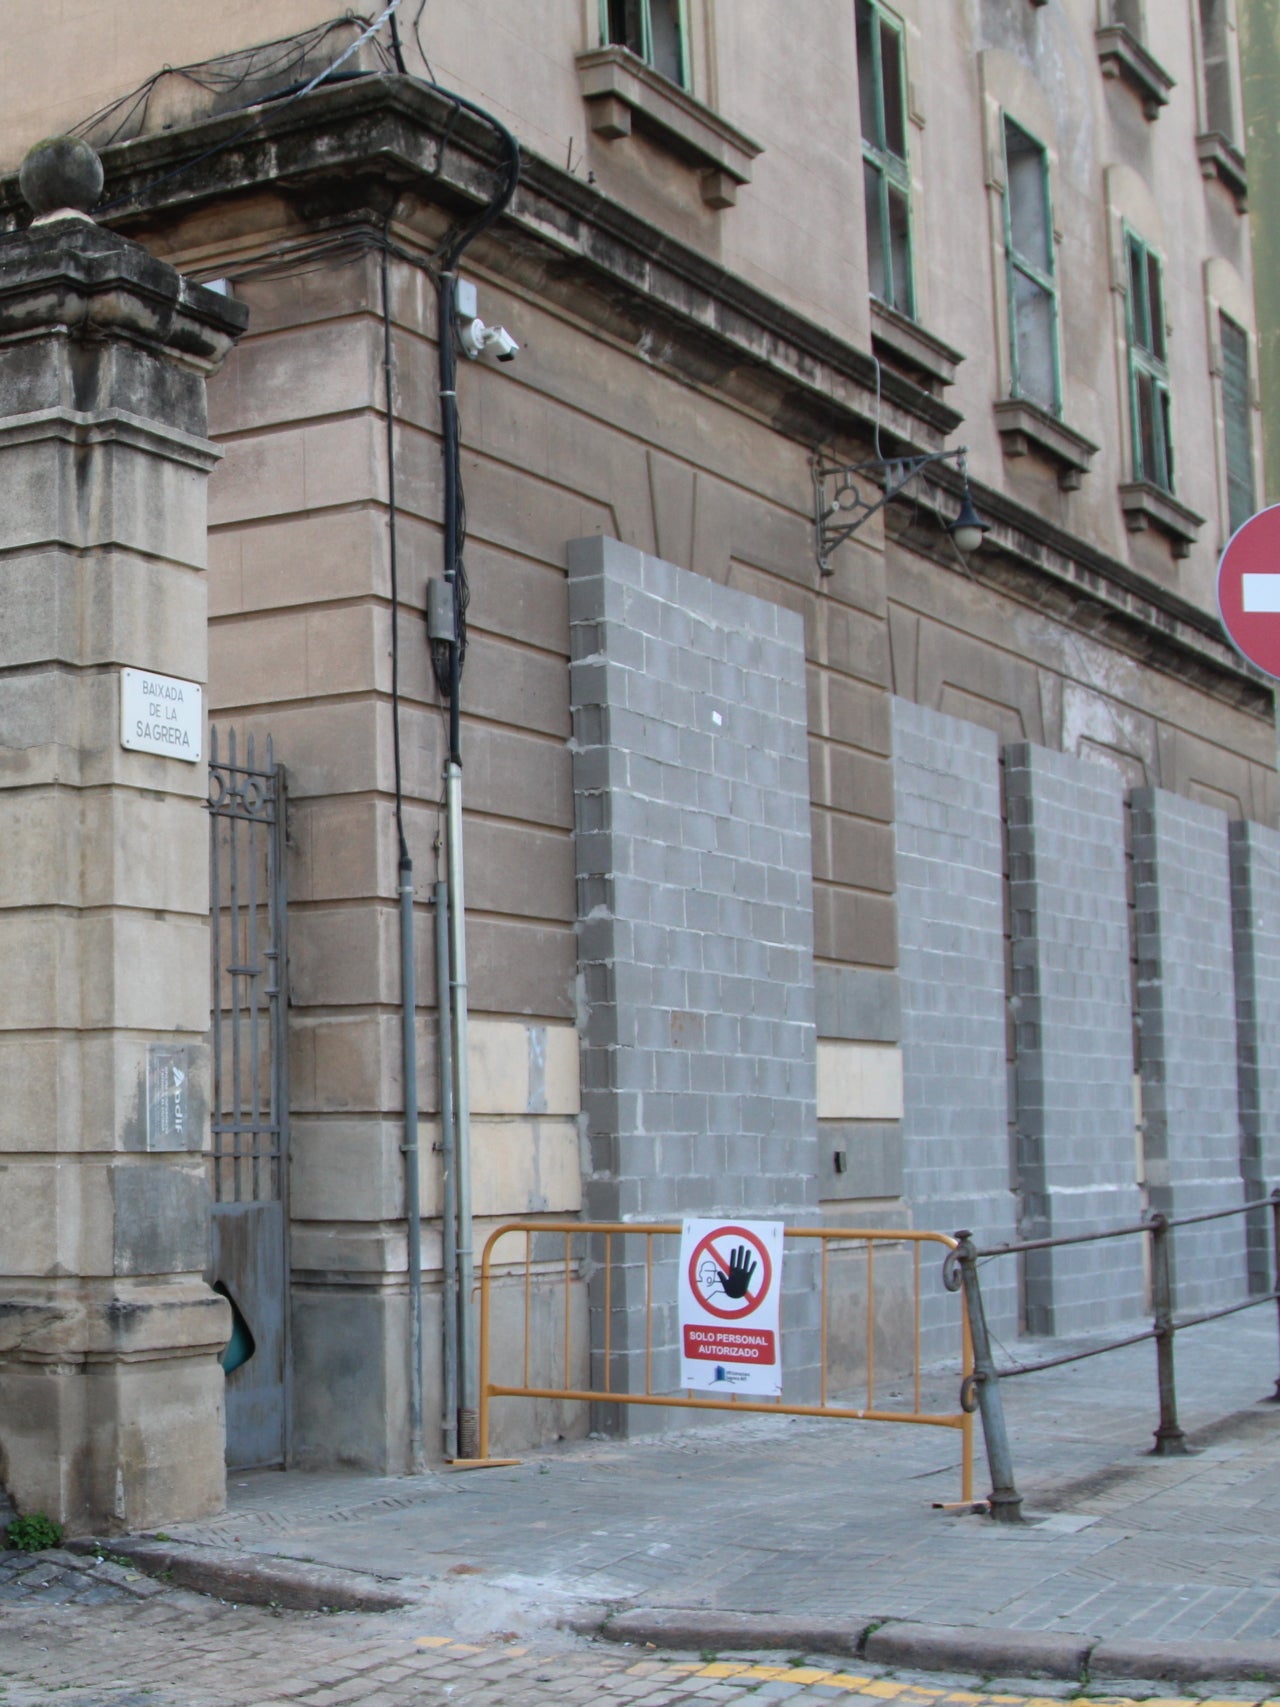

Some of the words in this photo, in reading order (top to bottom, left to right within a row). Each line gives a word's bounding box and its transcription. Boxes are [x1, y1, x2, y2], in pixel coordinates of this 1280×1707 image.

[142, 680, 184, 702] BAIXADA
[149, 702, 161, 718] DE
[165, 706, 178, 721] LA
[136, 720, 190, 748] SAGRERA
[689, 1331, 715, 1343] SOLO
[716, 1333, 768, 1346] PERSONAL
[698, 1344, 759, 1358] AUTORIZADO
